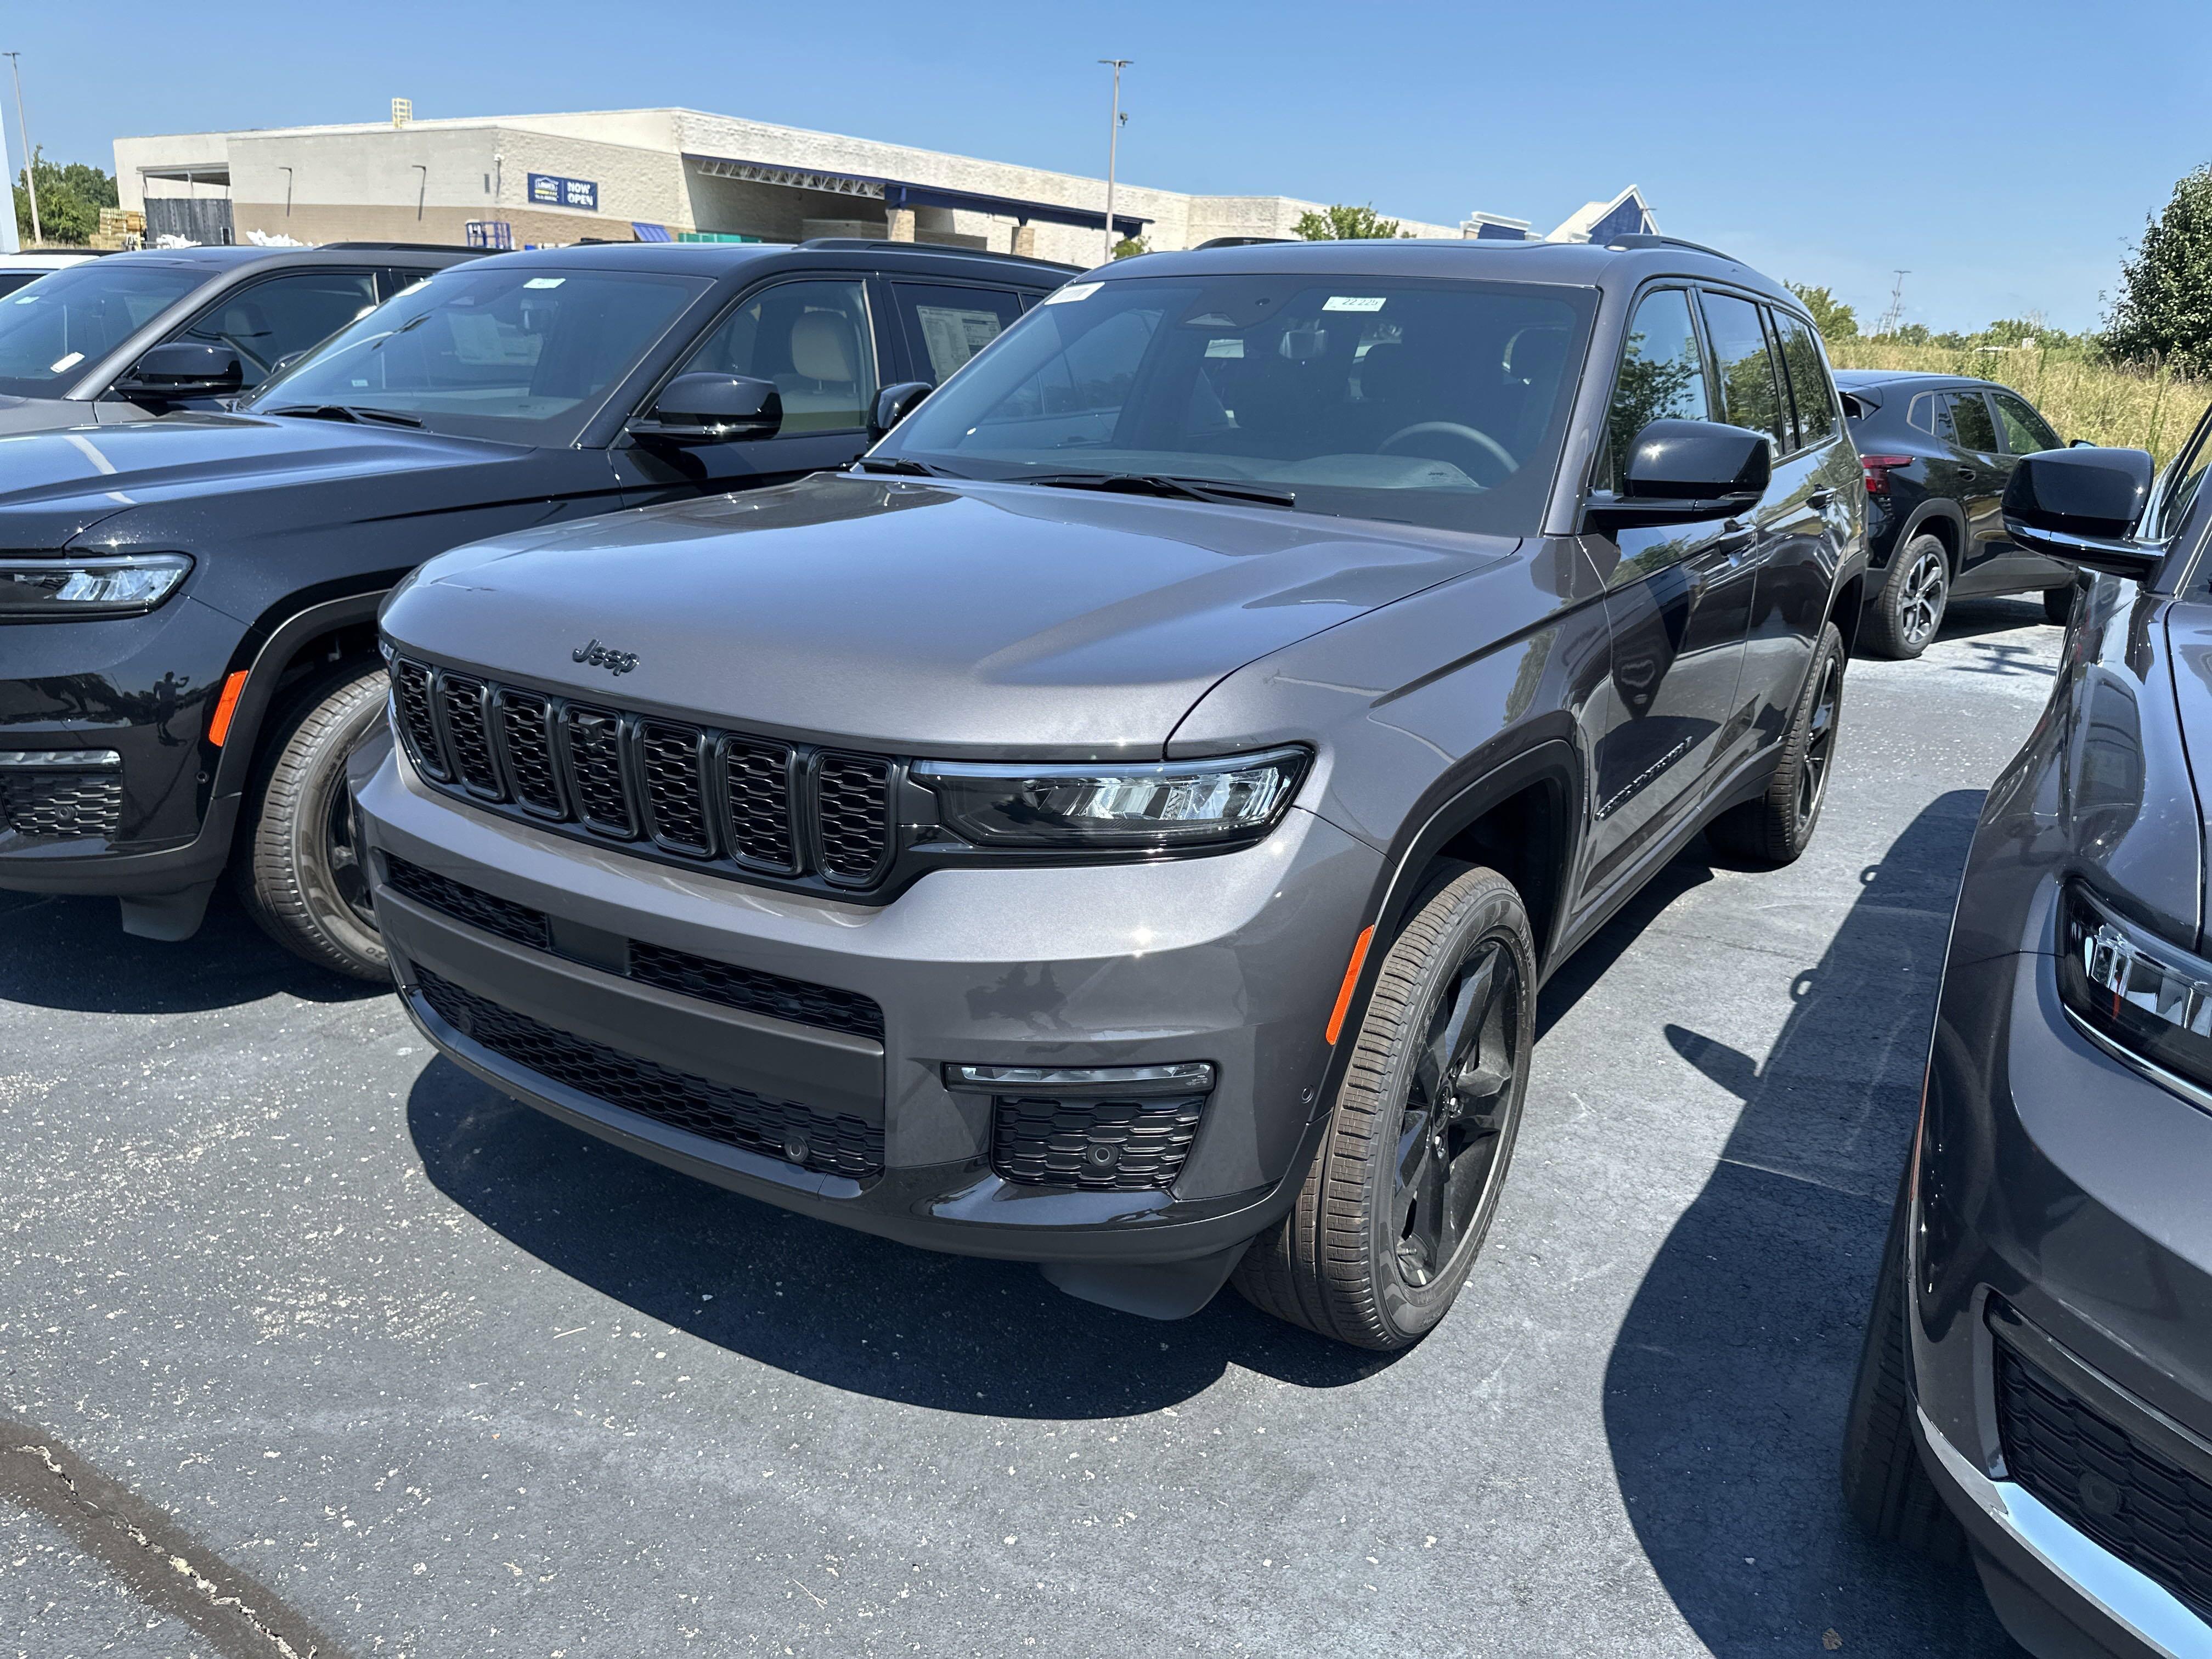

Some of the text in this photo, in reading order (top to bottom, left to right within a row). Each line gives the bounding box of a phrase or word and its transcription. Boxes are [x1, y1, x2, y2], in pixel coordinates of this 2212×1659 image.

[567, 181, 591, 194] NOW
[567, 193, 594, 206] OPEN
[572, 639, 640, 676] Jeep
